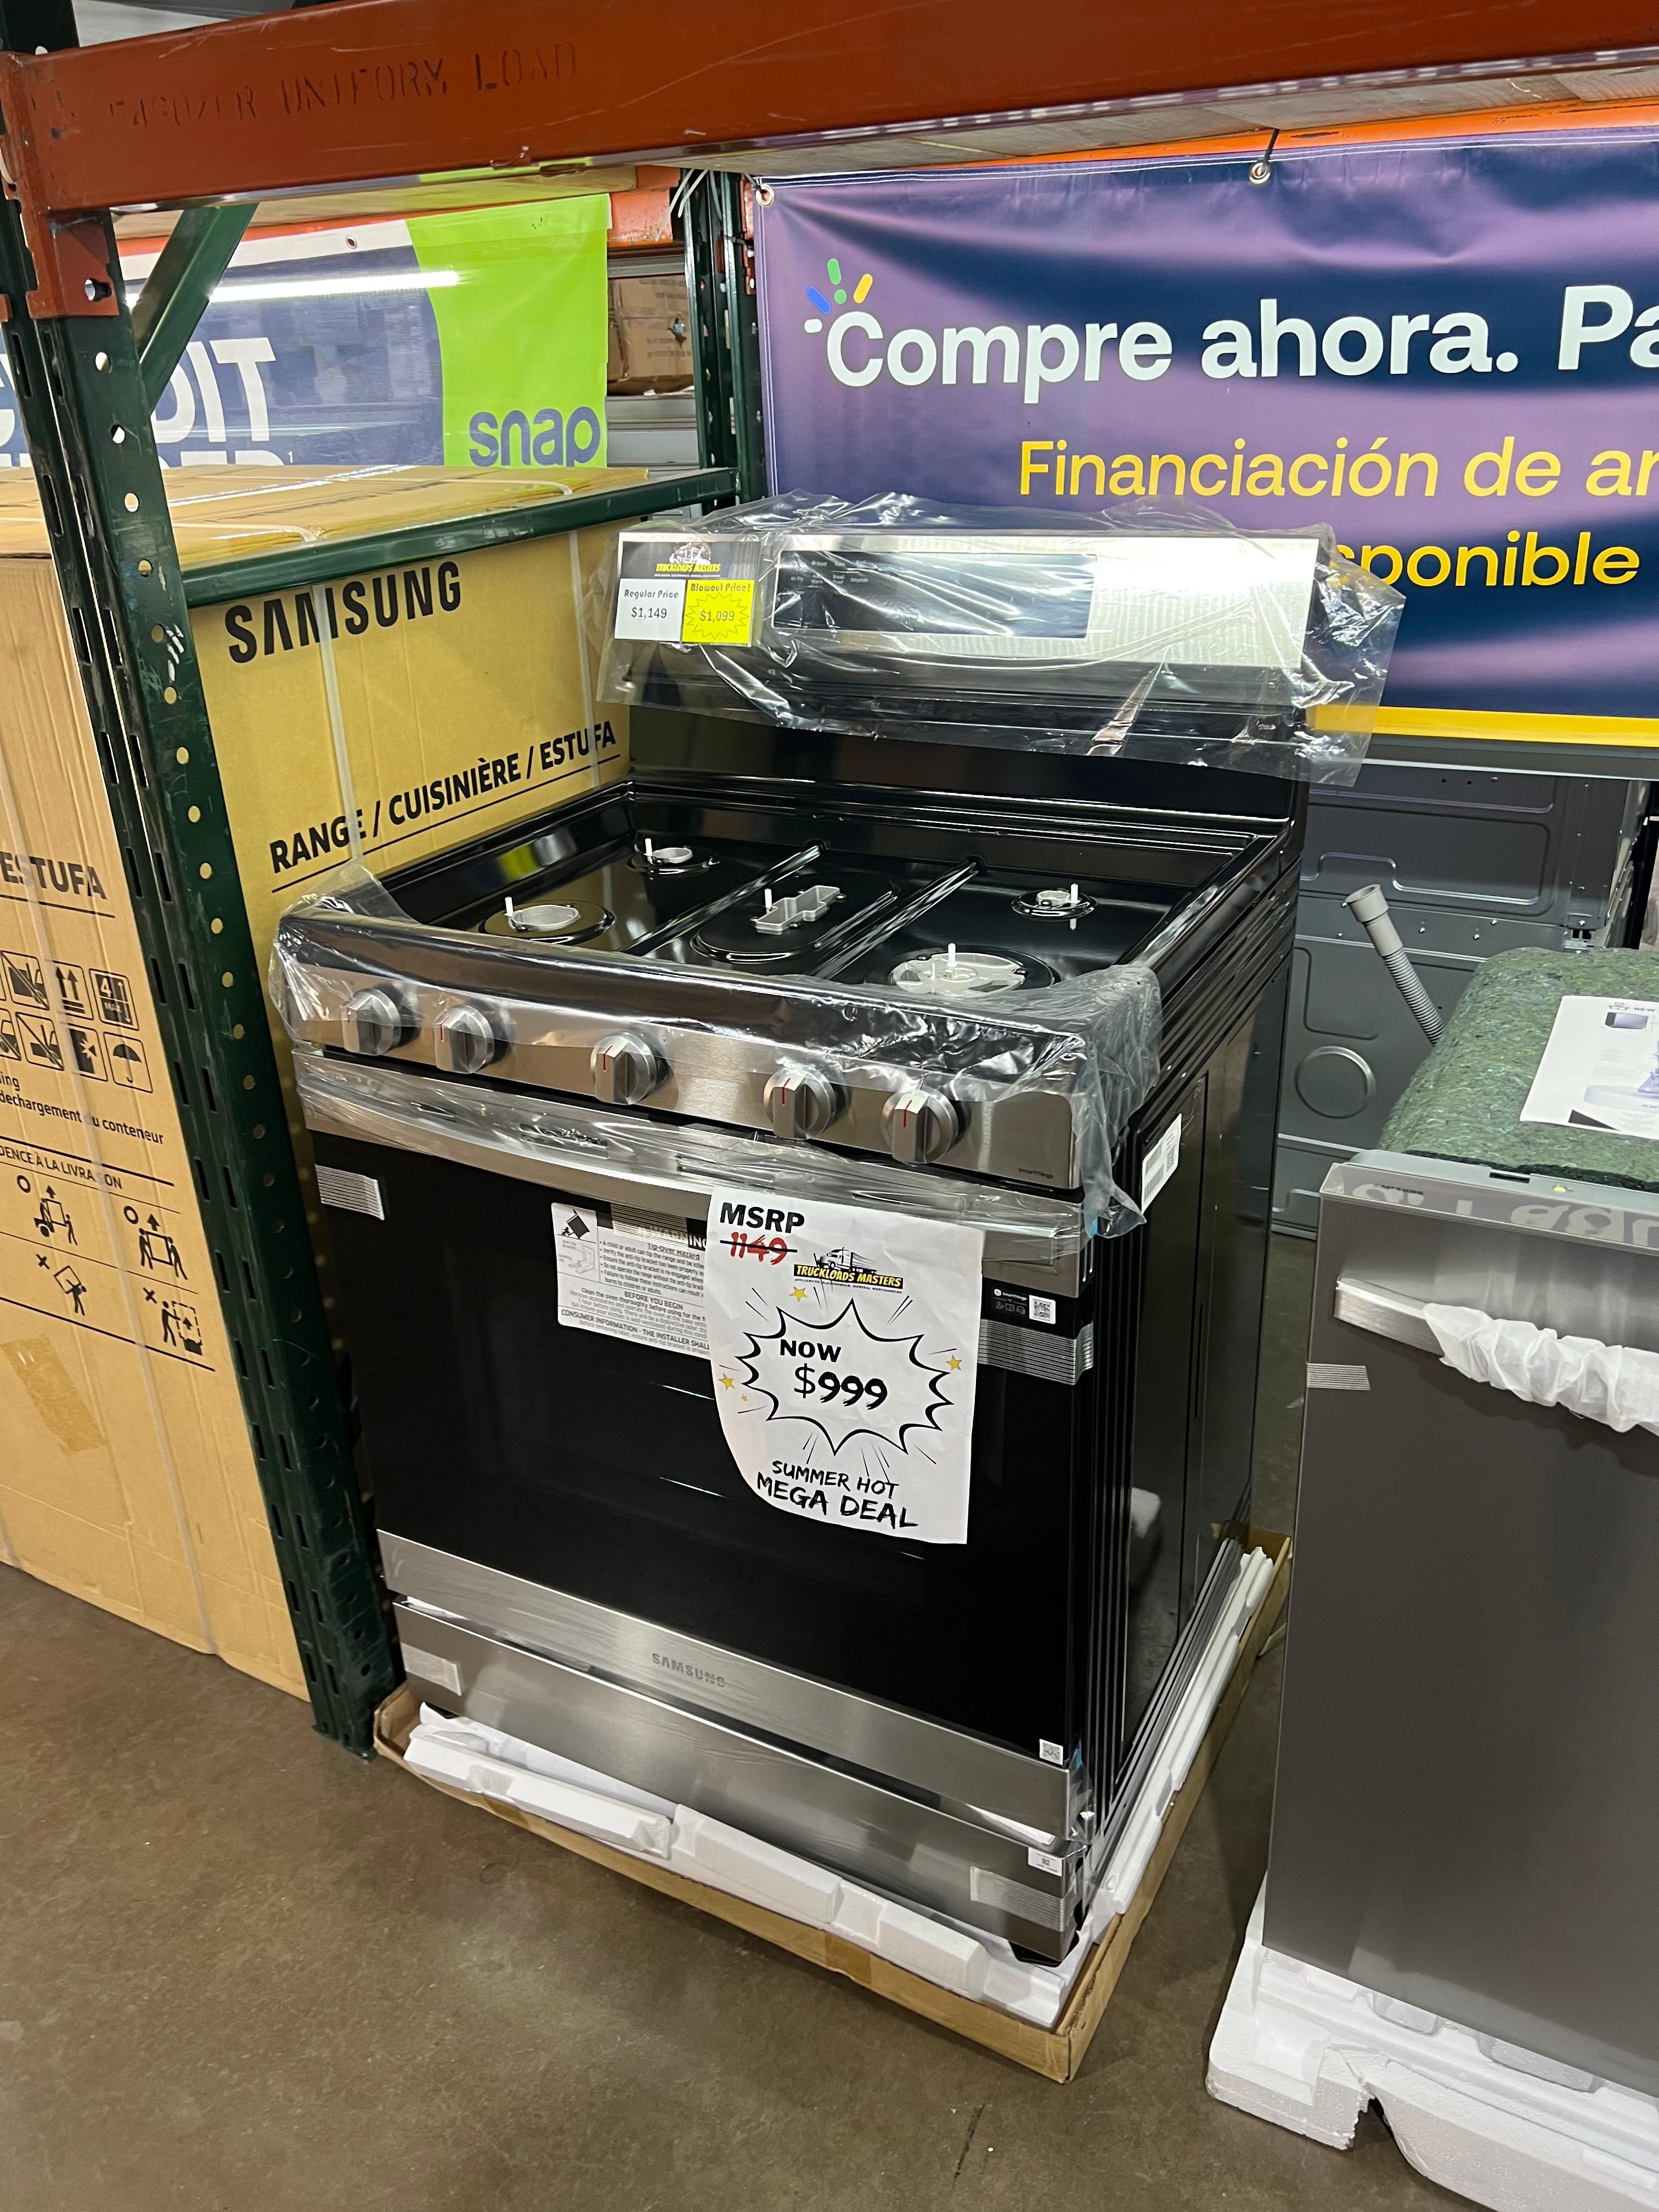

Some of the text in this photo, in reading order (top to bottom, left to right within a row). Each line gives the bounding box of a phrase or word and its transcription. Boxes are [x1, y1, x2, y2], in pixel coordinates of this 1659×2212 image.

[281, 58, 447, 114] UNIFORM
[827, 311, 1172, 404] Compre
[1201, 298, 1519, 379] ahora.
[469, 406, 601, 467] snap
[1020, 437, 1438, 496] Financiación
[1464, 436, 1561, 497] de
[624, 589, 679, 599] Regular Price
[691, 583, 751, 592] Blowout Price!
[225, 561, 461, 664] SAMSUNG
[631, 607, 667, 619] $1,149
[699, 610, 735, 623] $1,099
[389, 757, 521, 825] CUISINIÈRE
[540, 721, 616, 771] ESTUFA
[100, 978, 111, 997] 4
[0, 1072, 20, 1091] ing
[102, 1119, 163, 1146] conteneur
[44, 1158, 60, 1171] LA
[60, 1161, 122, 1189] LIVRAON
[720, 1203, 805, 1233] MSRP
[730, 1232, 788, 1265] 1149
[797, 1265, 902, 1288] TRUCKLOADS MASTERS
[624, 1290, 683, 1310] BEFORE YOU BEGIN
[561, 1308, 594, 1322] CONSUMER
[596, 1317, 637, 1332] INFORMATION
[642, 1329, 654, 1337] THE
[656, 1331, 689, 1345] INSTALLER
[780, 1339, 841, 1363] NOW
[794, 1363, 888, 1410] $999
[772, 1460, 899, 1499] SUMMER HOT
[757, 1472, 918, 1529] MEGA DEAL
[652, 1653, 726, 1688] SAMSUNG
